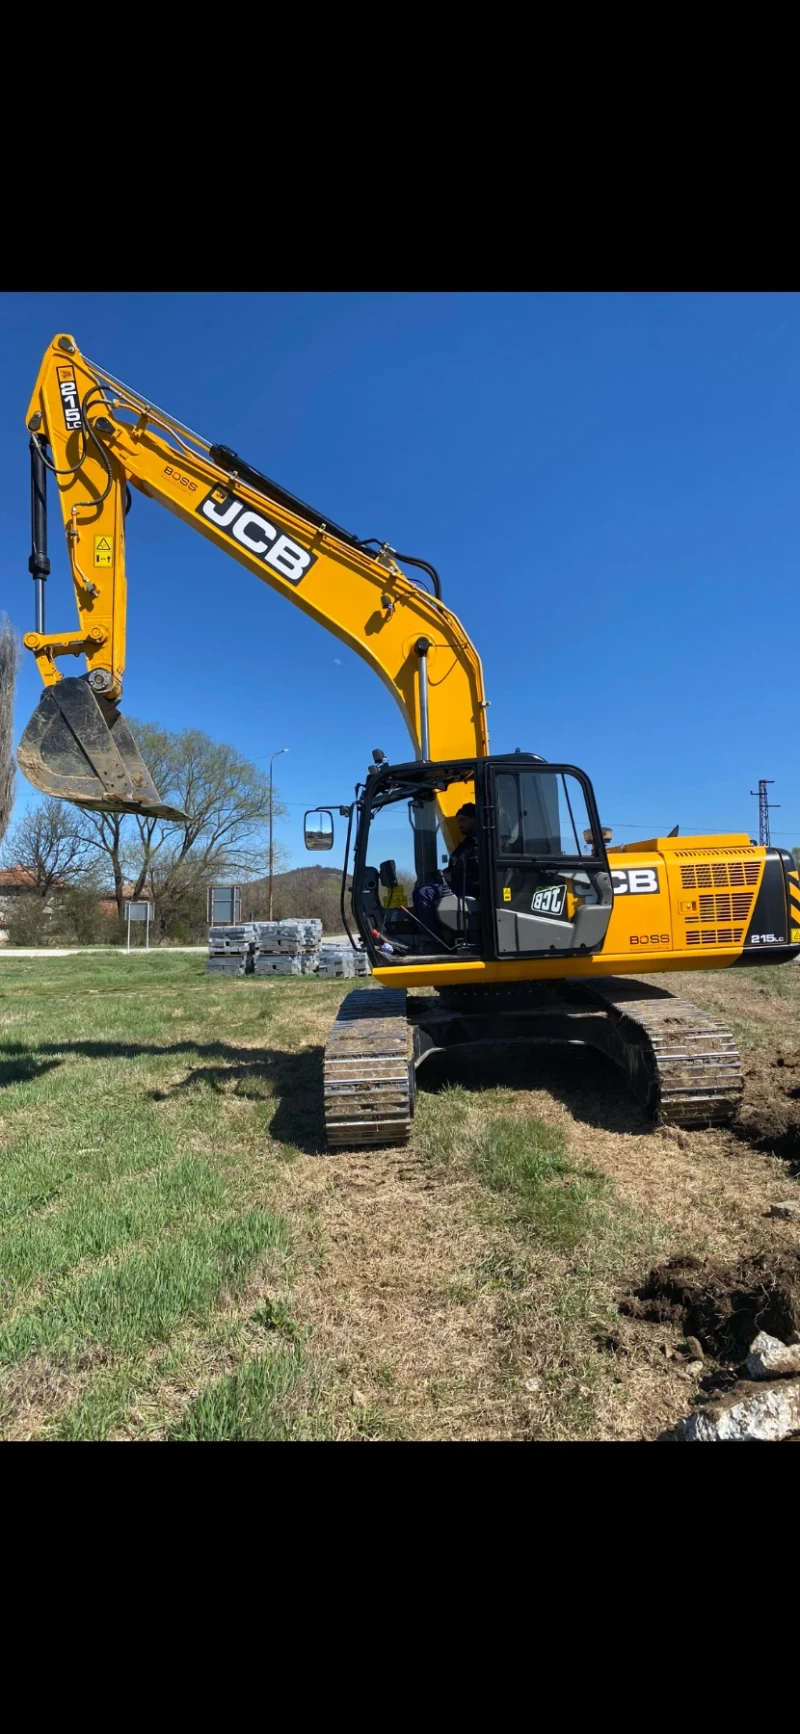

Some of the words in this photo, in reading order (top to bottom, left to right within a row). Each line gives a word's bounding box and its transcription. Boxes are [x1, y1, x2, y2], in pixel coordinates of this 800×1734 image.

[163, 465, 198, 492] BOSS
[202, 499, 311, 581] JCB
[629, 935, 670, 945] BOSS
